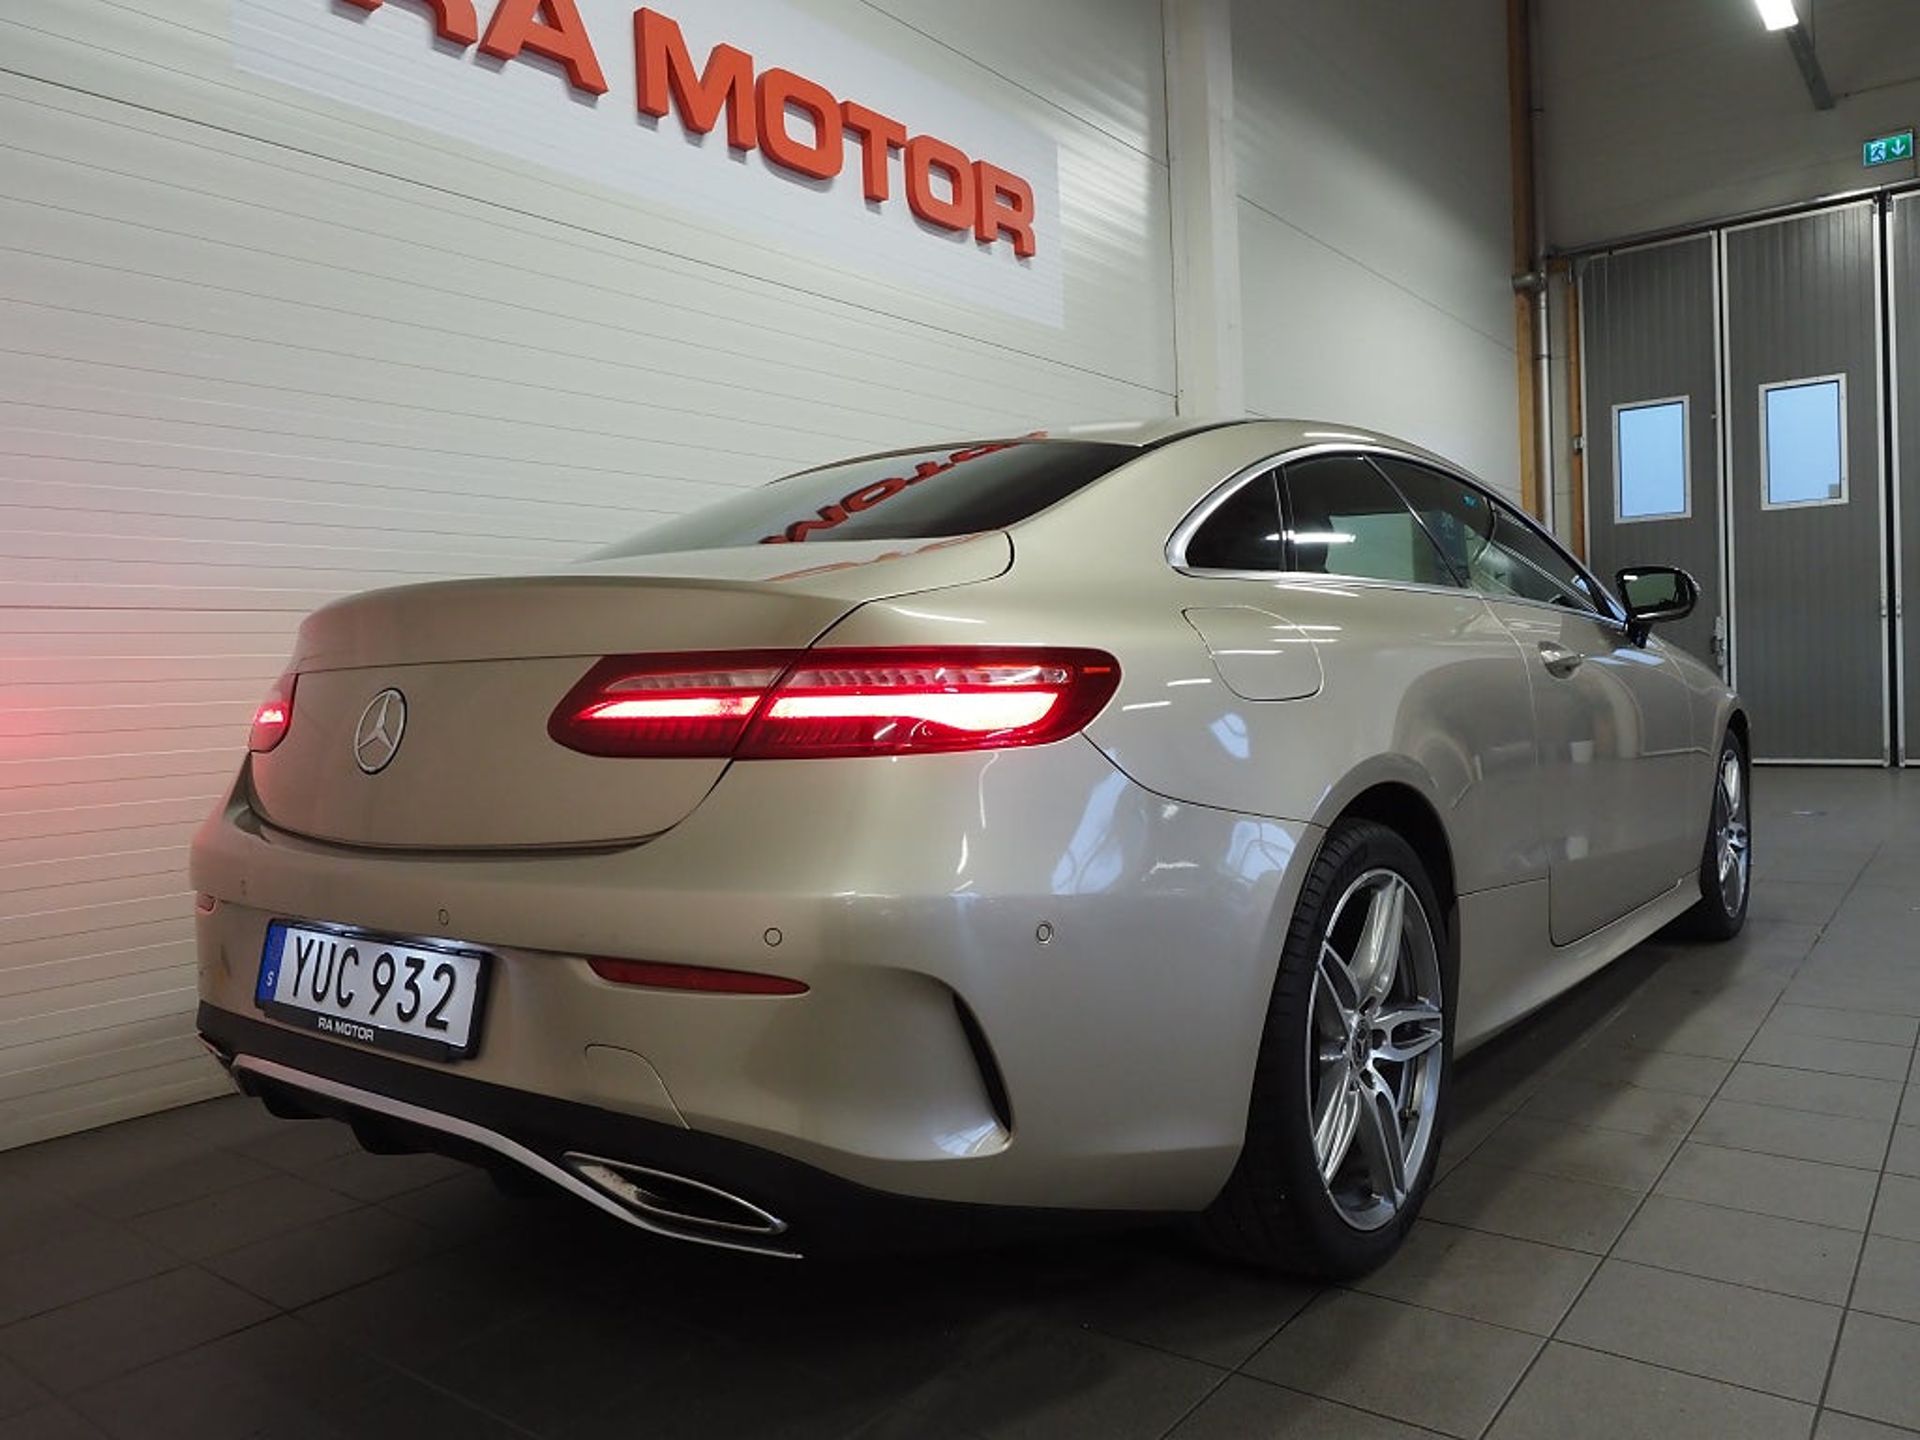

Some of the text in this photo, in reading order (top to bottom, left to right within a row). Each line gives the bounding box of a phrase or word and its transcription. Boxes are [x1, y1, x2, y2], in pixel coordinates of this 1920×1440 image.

[633, 7, 1036, 259] MOTOR
[265, 970, 274, 987] S
[293, 936, 456, 1031] YUC 932
[318, 1017, 374, 1042] RA MOTOR
